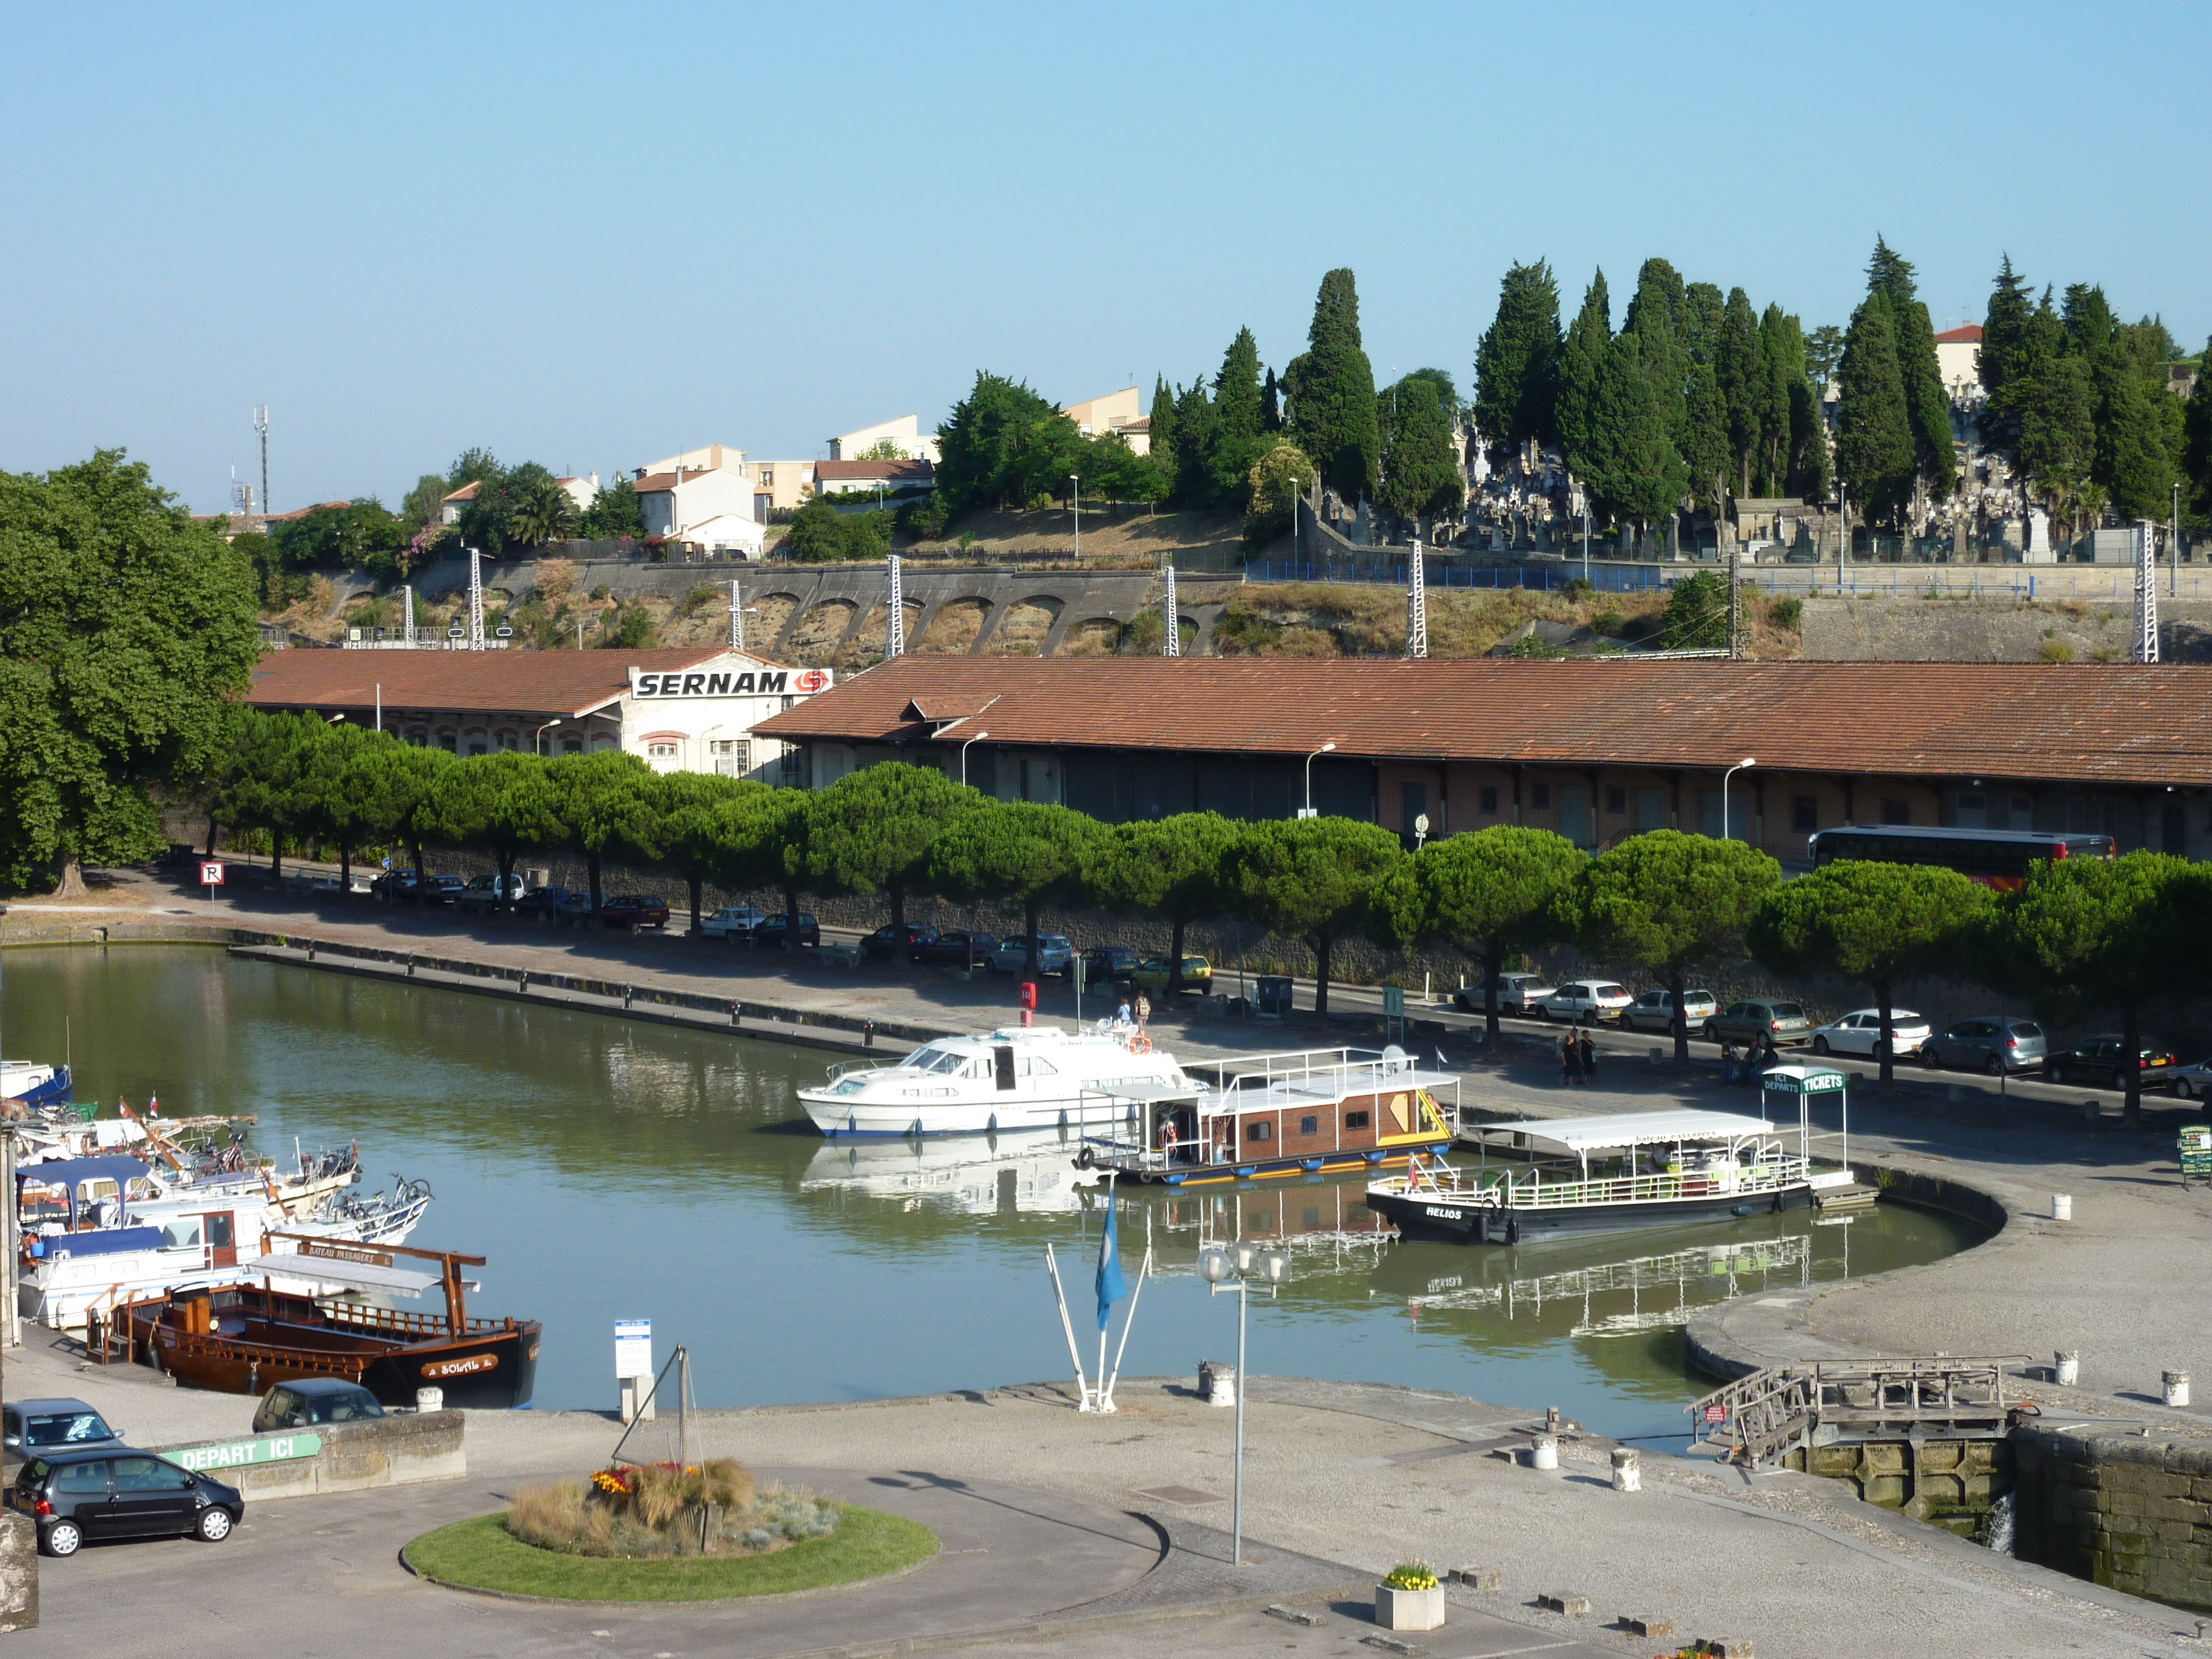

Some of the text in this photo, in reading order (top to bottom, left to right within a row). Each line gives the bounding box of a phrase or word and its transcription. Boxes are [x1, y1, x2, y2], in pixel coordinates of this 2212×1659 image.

[637, 672, 788, 696] SERNAM
[1774, 1074, 1786, 1082] ICI
[1803, 1074, 1843, 1091] TICKETS
[1765, 1081, 1799, 1093] DEPARTS
[1671, 1131, 1716, 1139] passagers
[1426, 1207, 1462, 1220] HELIOS
[309, 1247, 375, 1263] BATEAU PASSAGERS
[441, 1361, 479, 1375] SOLAL
[183, 1439, 293, 1470] DEPART ICI
